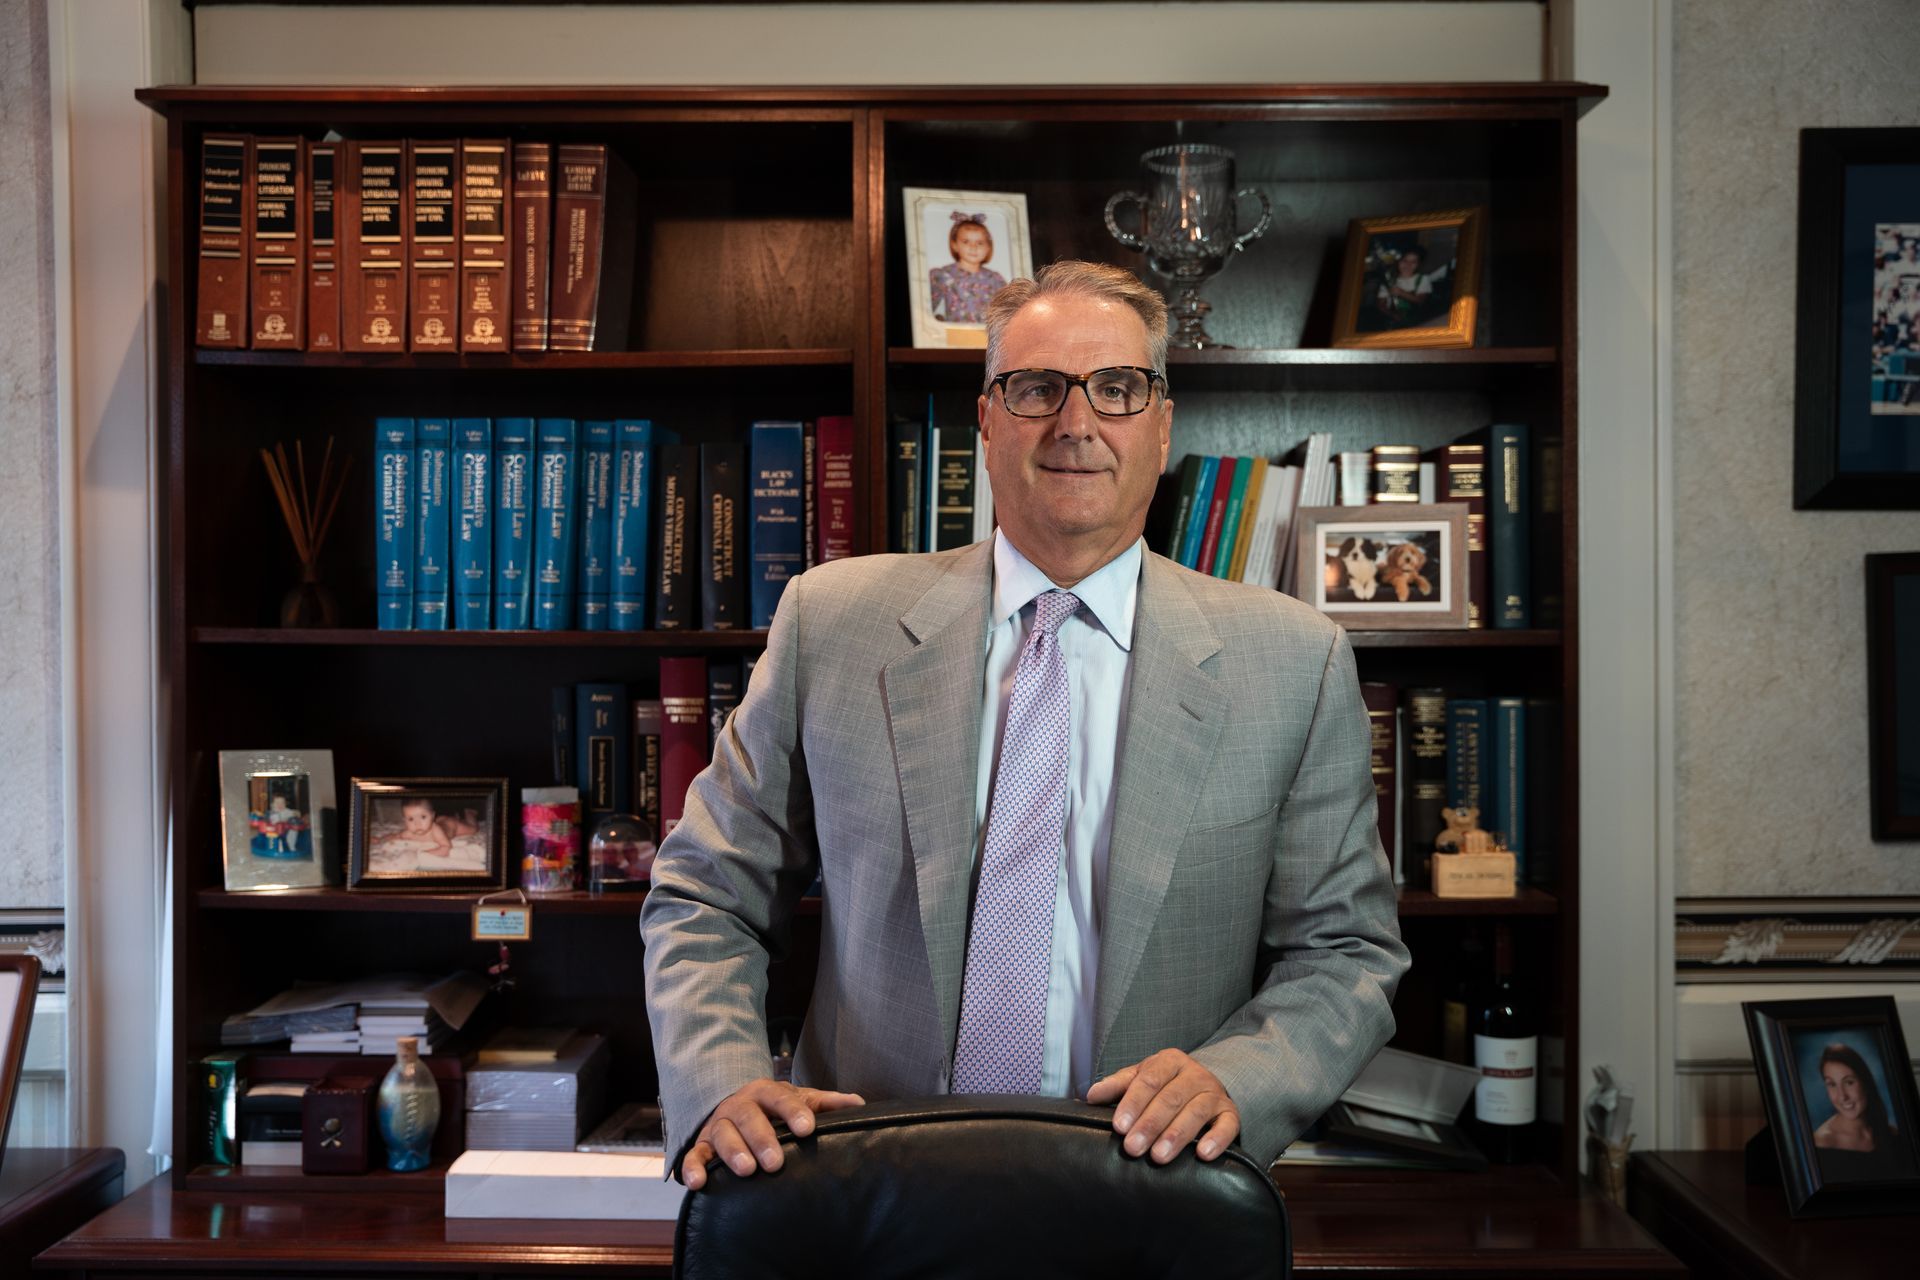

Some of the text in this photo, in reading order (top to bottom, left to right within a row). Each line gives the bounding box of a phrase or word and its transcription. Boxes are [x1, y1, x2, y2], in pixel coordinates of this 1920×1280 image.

[258, 185, 295, 195] LITIGATION
[362, 189, 399, 199] LITIGATION
[416, 189, 453, 199] LITIGATION
[465, 188, 503, 198] LITIGATION
[526, 206, 535, 311] MODERN CRIMINAL LAW
[395, 453, 408, 528] Substantive
[421, 449, 432, 493] Criminal
[434, 450, 444, 506] Substantive
[474, 453, 487, 528] Substantive
[502, 455, 515, 509] Defenses
[512, 454, 526, 509] Criminal
[542, 454, 555, 509] Defenses
[552, 453, 566, 509] Criminal
[587, 452, 598, 496] Criminal
[598, 452, 610, 509] Substantive
[620, 450, 631, 494] Criminal
[631, 451, 644, 508] Substantive
[754, 488, 800, 498] DICTIONARY
[768, 479, 786, 488] LAW
[383, 453, 395, 542] Criminal Law
[421, 495, 431, 518] Law
[462, 453, 475, 542] Criminal Law
[586, 496, 597, 520] Law
[619, 496, 630, 518] Law
[665, 475, 676, 516] MOTOR
[512, 512, 526, 539] Law
[552, 512, 565, 539] Law
[672, 496, 684, 575] CONNECTICUT
[712, 493, 723, 583] CRIMINAL LAW
[723, 498, 733, 577] CONNECTICUT
[662, 570, 672, 596] LAW
